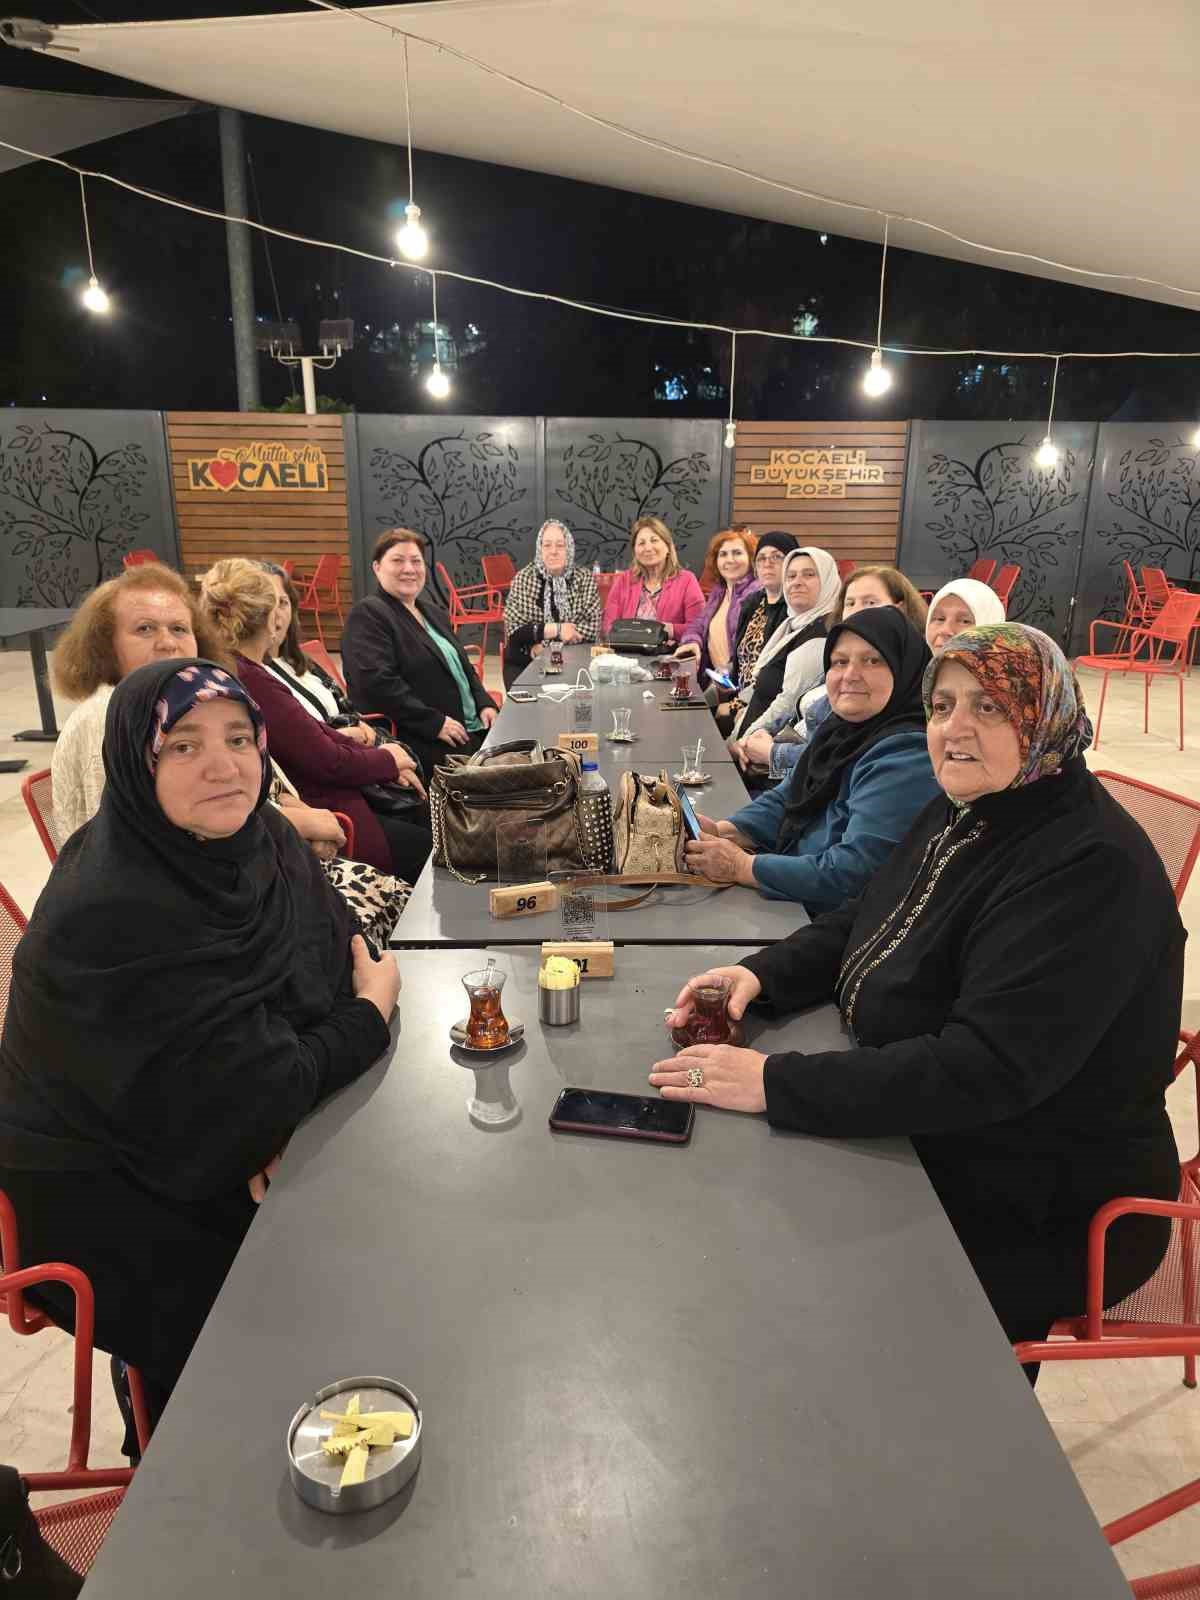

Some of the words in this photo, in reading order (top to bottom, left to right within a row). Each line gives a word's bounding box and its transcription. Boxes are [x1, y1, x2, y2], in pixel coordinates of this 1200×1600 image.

[788, 483, 844, 496] 2022
[570, 740, 588, 750] 100
[516, 895, 537, 911] 96
